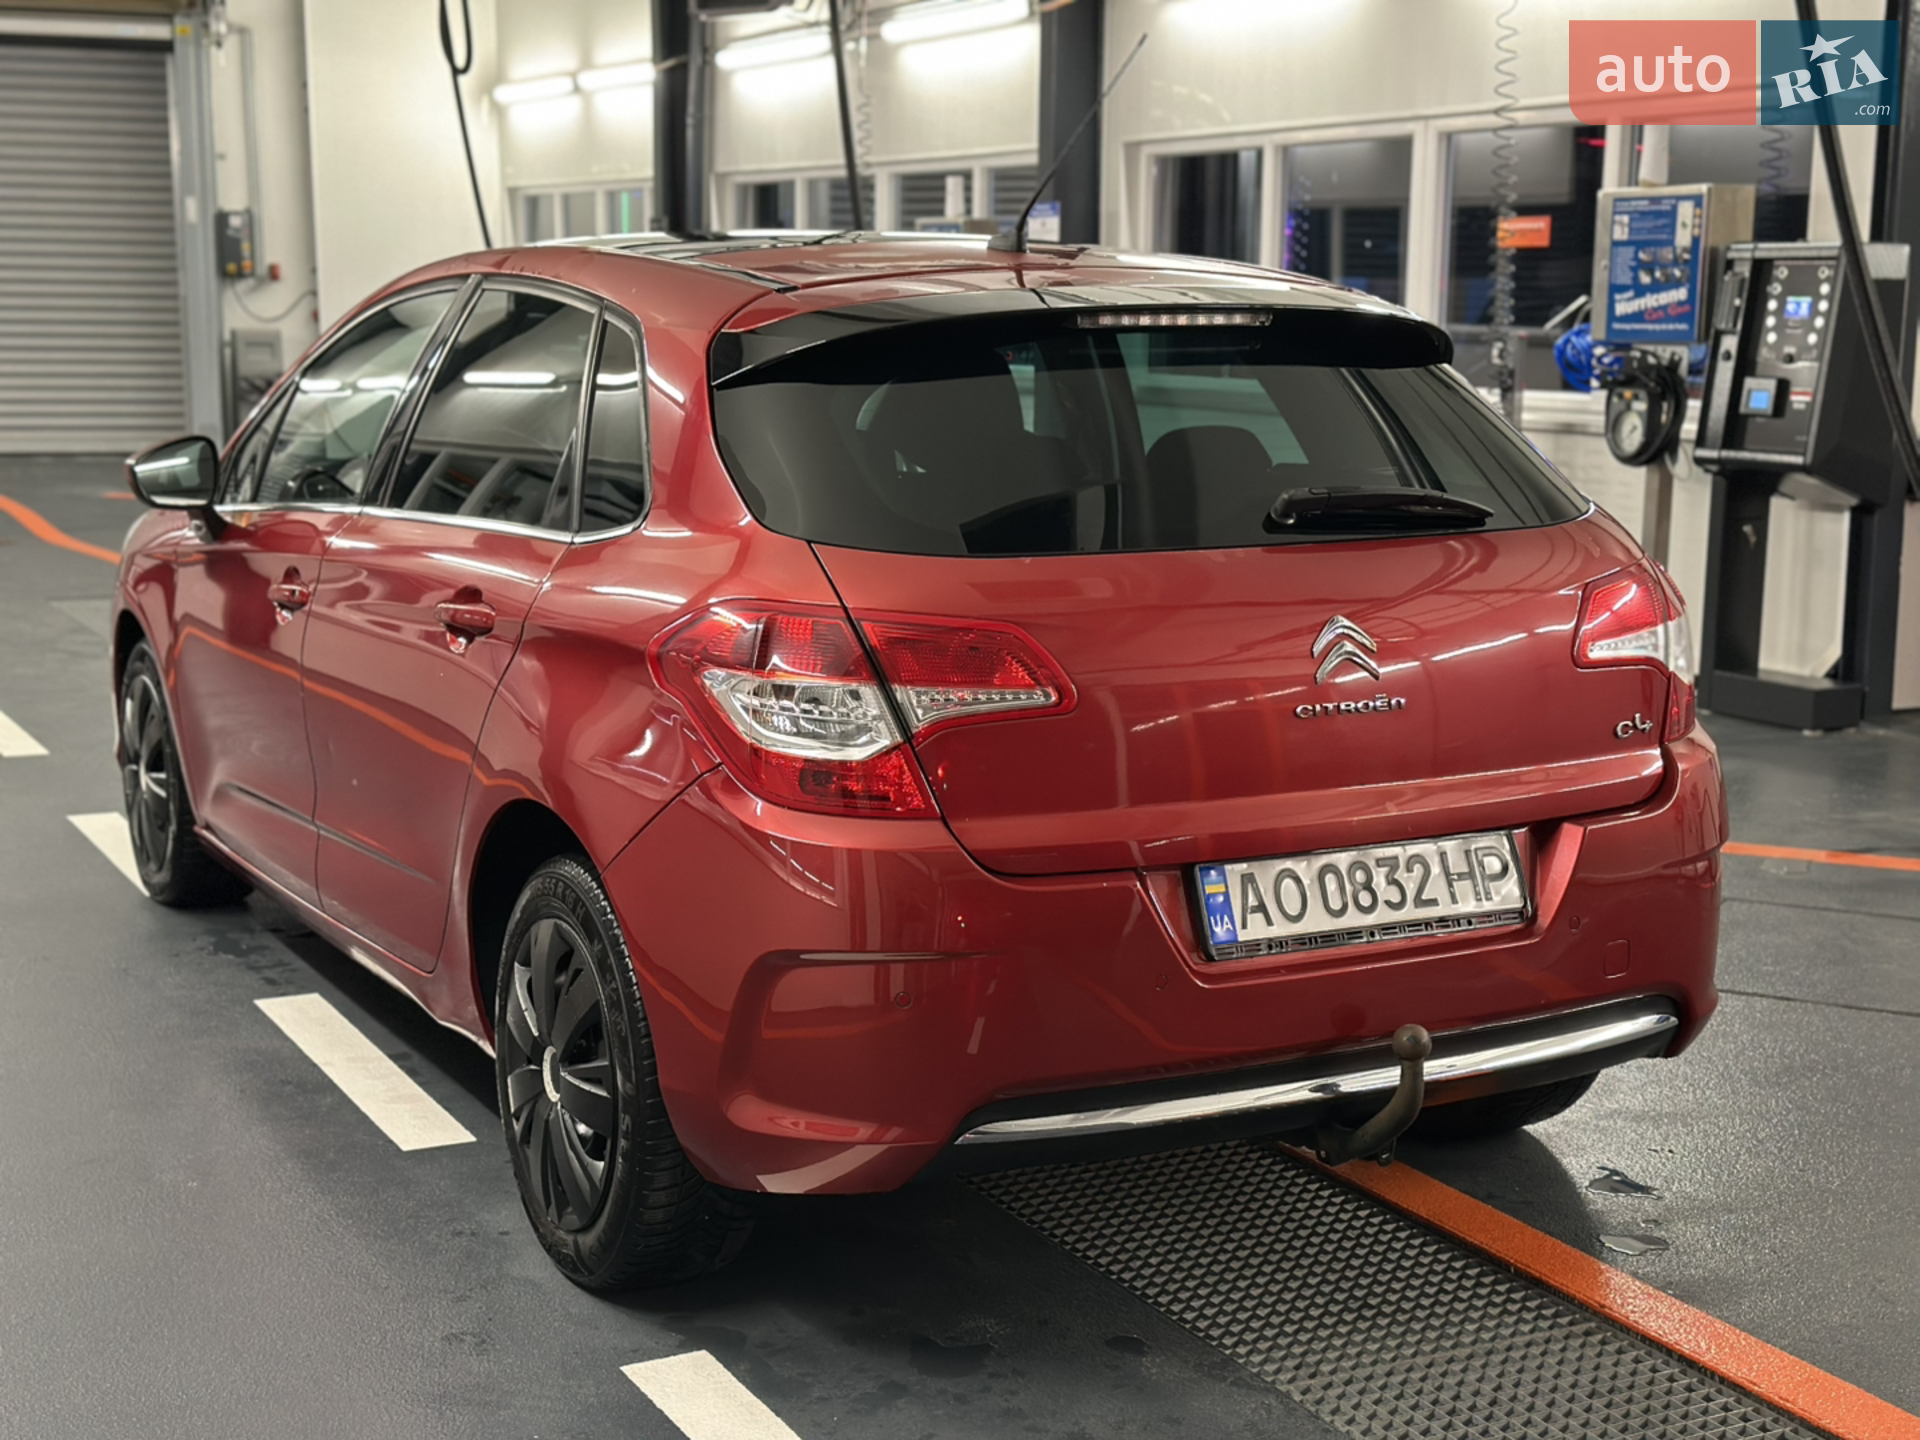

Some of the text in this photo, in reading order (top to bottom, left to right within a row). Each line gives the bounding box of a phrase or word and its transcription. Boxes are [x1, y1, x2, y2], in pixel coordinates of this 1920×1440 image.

[1614, 713, 1653, 739] C4
[1240, 867, 1308, 930] AO
[1318, 853, 1440, 919] 0832
[1210, 914, 1234, 933] UA
